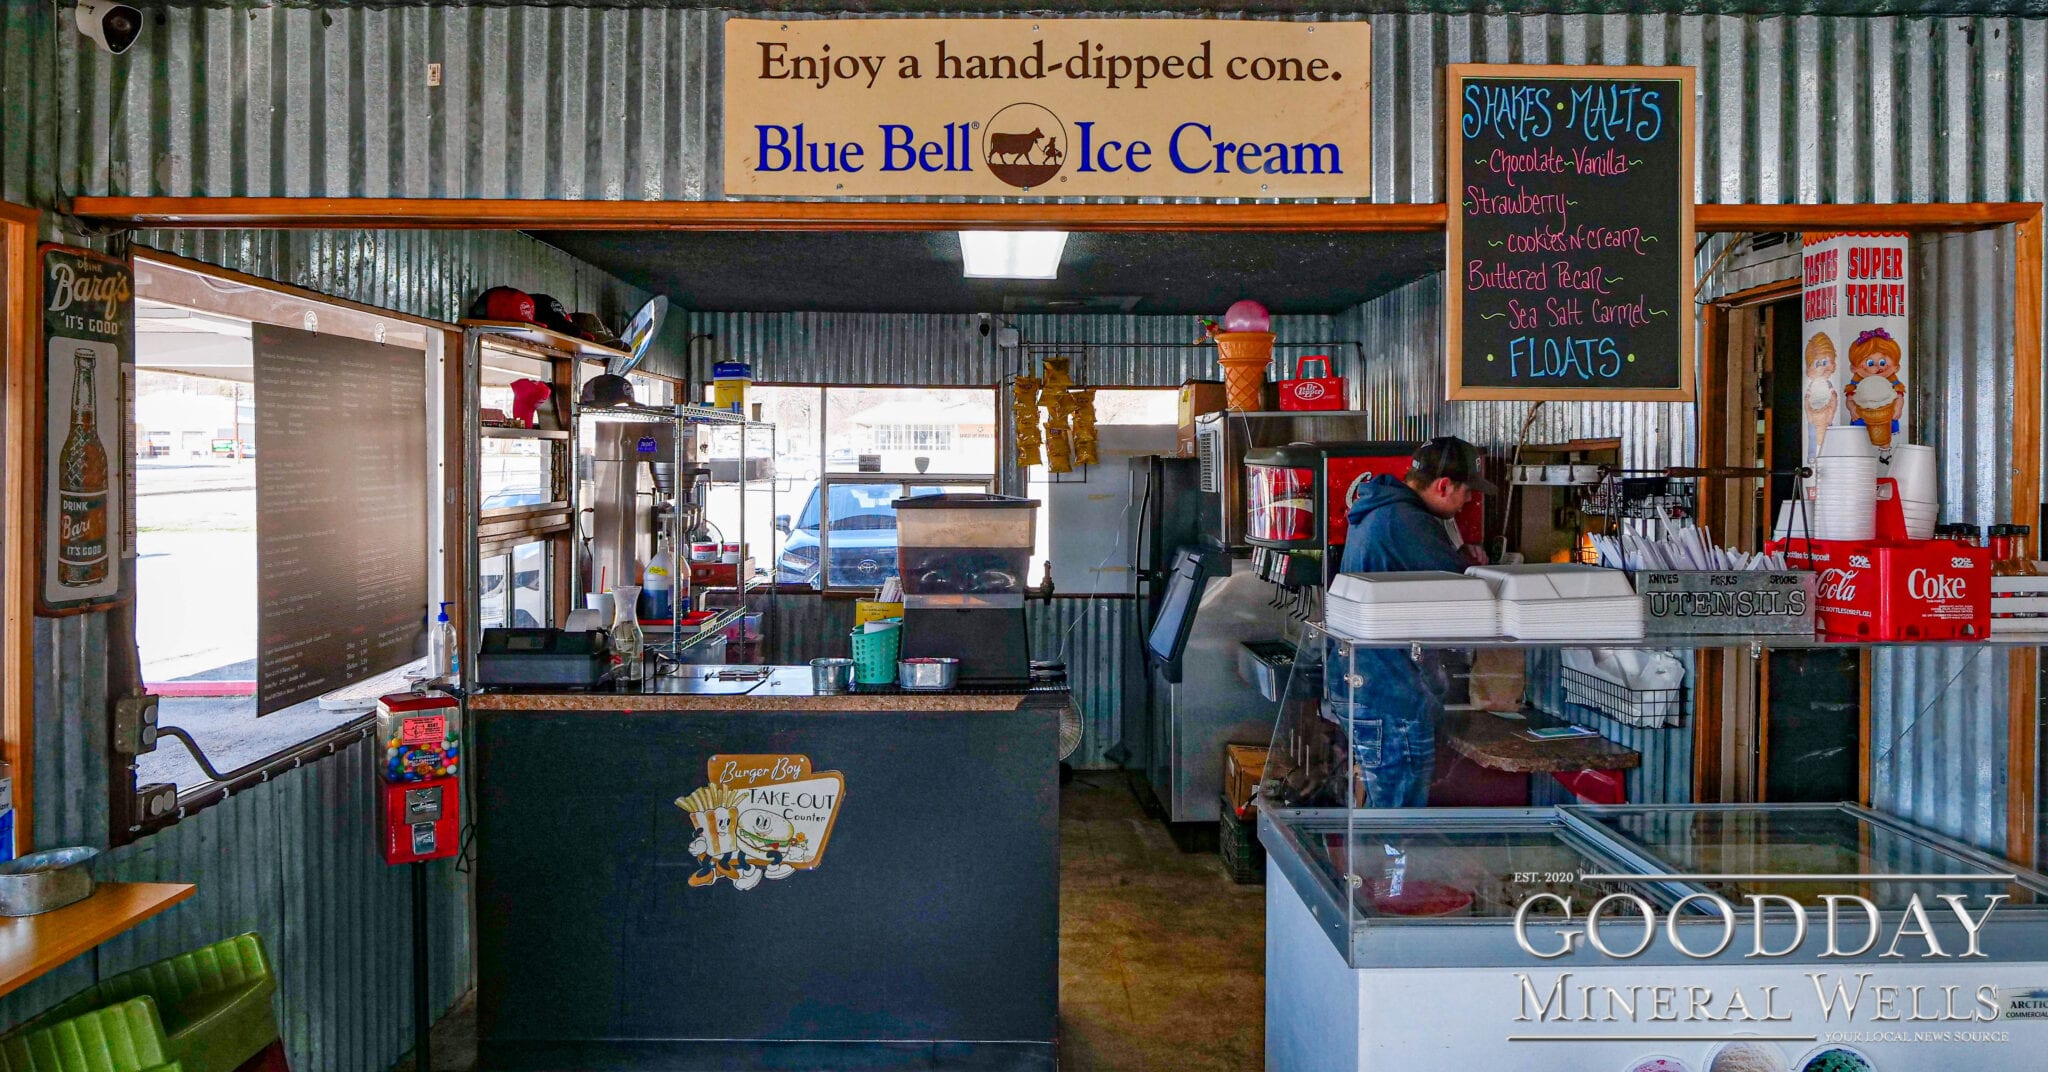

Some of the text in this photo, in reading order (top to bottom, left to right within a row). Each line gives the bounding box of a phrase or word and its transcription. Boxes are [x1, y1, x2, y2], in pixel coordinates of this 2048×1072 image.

[757, 41, 1342, 89] Enjoy a hand-dipped cone.
[1462, 84, 1662, 142] SHAKES MALTS
[754, 120, 1343, 176] Blue Bell Ice Cream
[1489, 145, 1629, 187] Chocolate Vanilla
[1467, 185, 1568, 237] Strawberry
[1467, 259, 1611, 294] Buttered Pecan
[1804, 248, 1838, 287] TASTES
[1848, 247, 1904, 280] SUPER
[48, 263, 131, 320] Barq's
[1805, 284, 1838, 323] GREAT!
[1846, 283, 1905, 317] TREAT!
[1508, 294, 1651, 330] Sea Salt Carmel
[1510, 335, 1622, 380] FLOATS
[1306, 383, 1318, 391] Dr
[63, 500, 89, 511] DRINK
[82, 545, 102, 556] GOOD
[1648, 574, 1798, 585] KNIVES FORKS SPOONS
[1815, 567, 1859, 602] Cola
[1908, 568, 1966, 599] Coke
[1646, 590, 1807, 617] UTENSILS
[720, 757, 801, 784] Burger Boy
[749, 788, 835, 810] TAKE-OUT
[783, 808, 826, 823] Counter
[2010, 1001, 2048, 1009] ARCTIC
